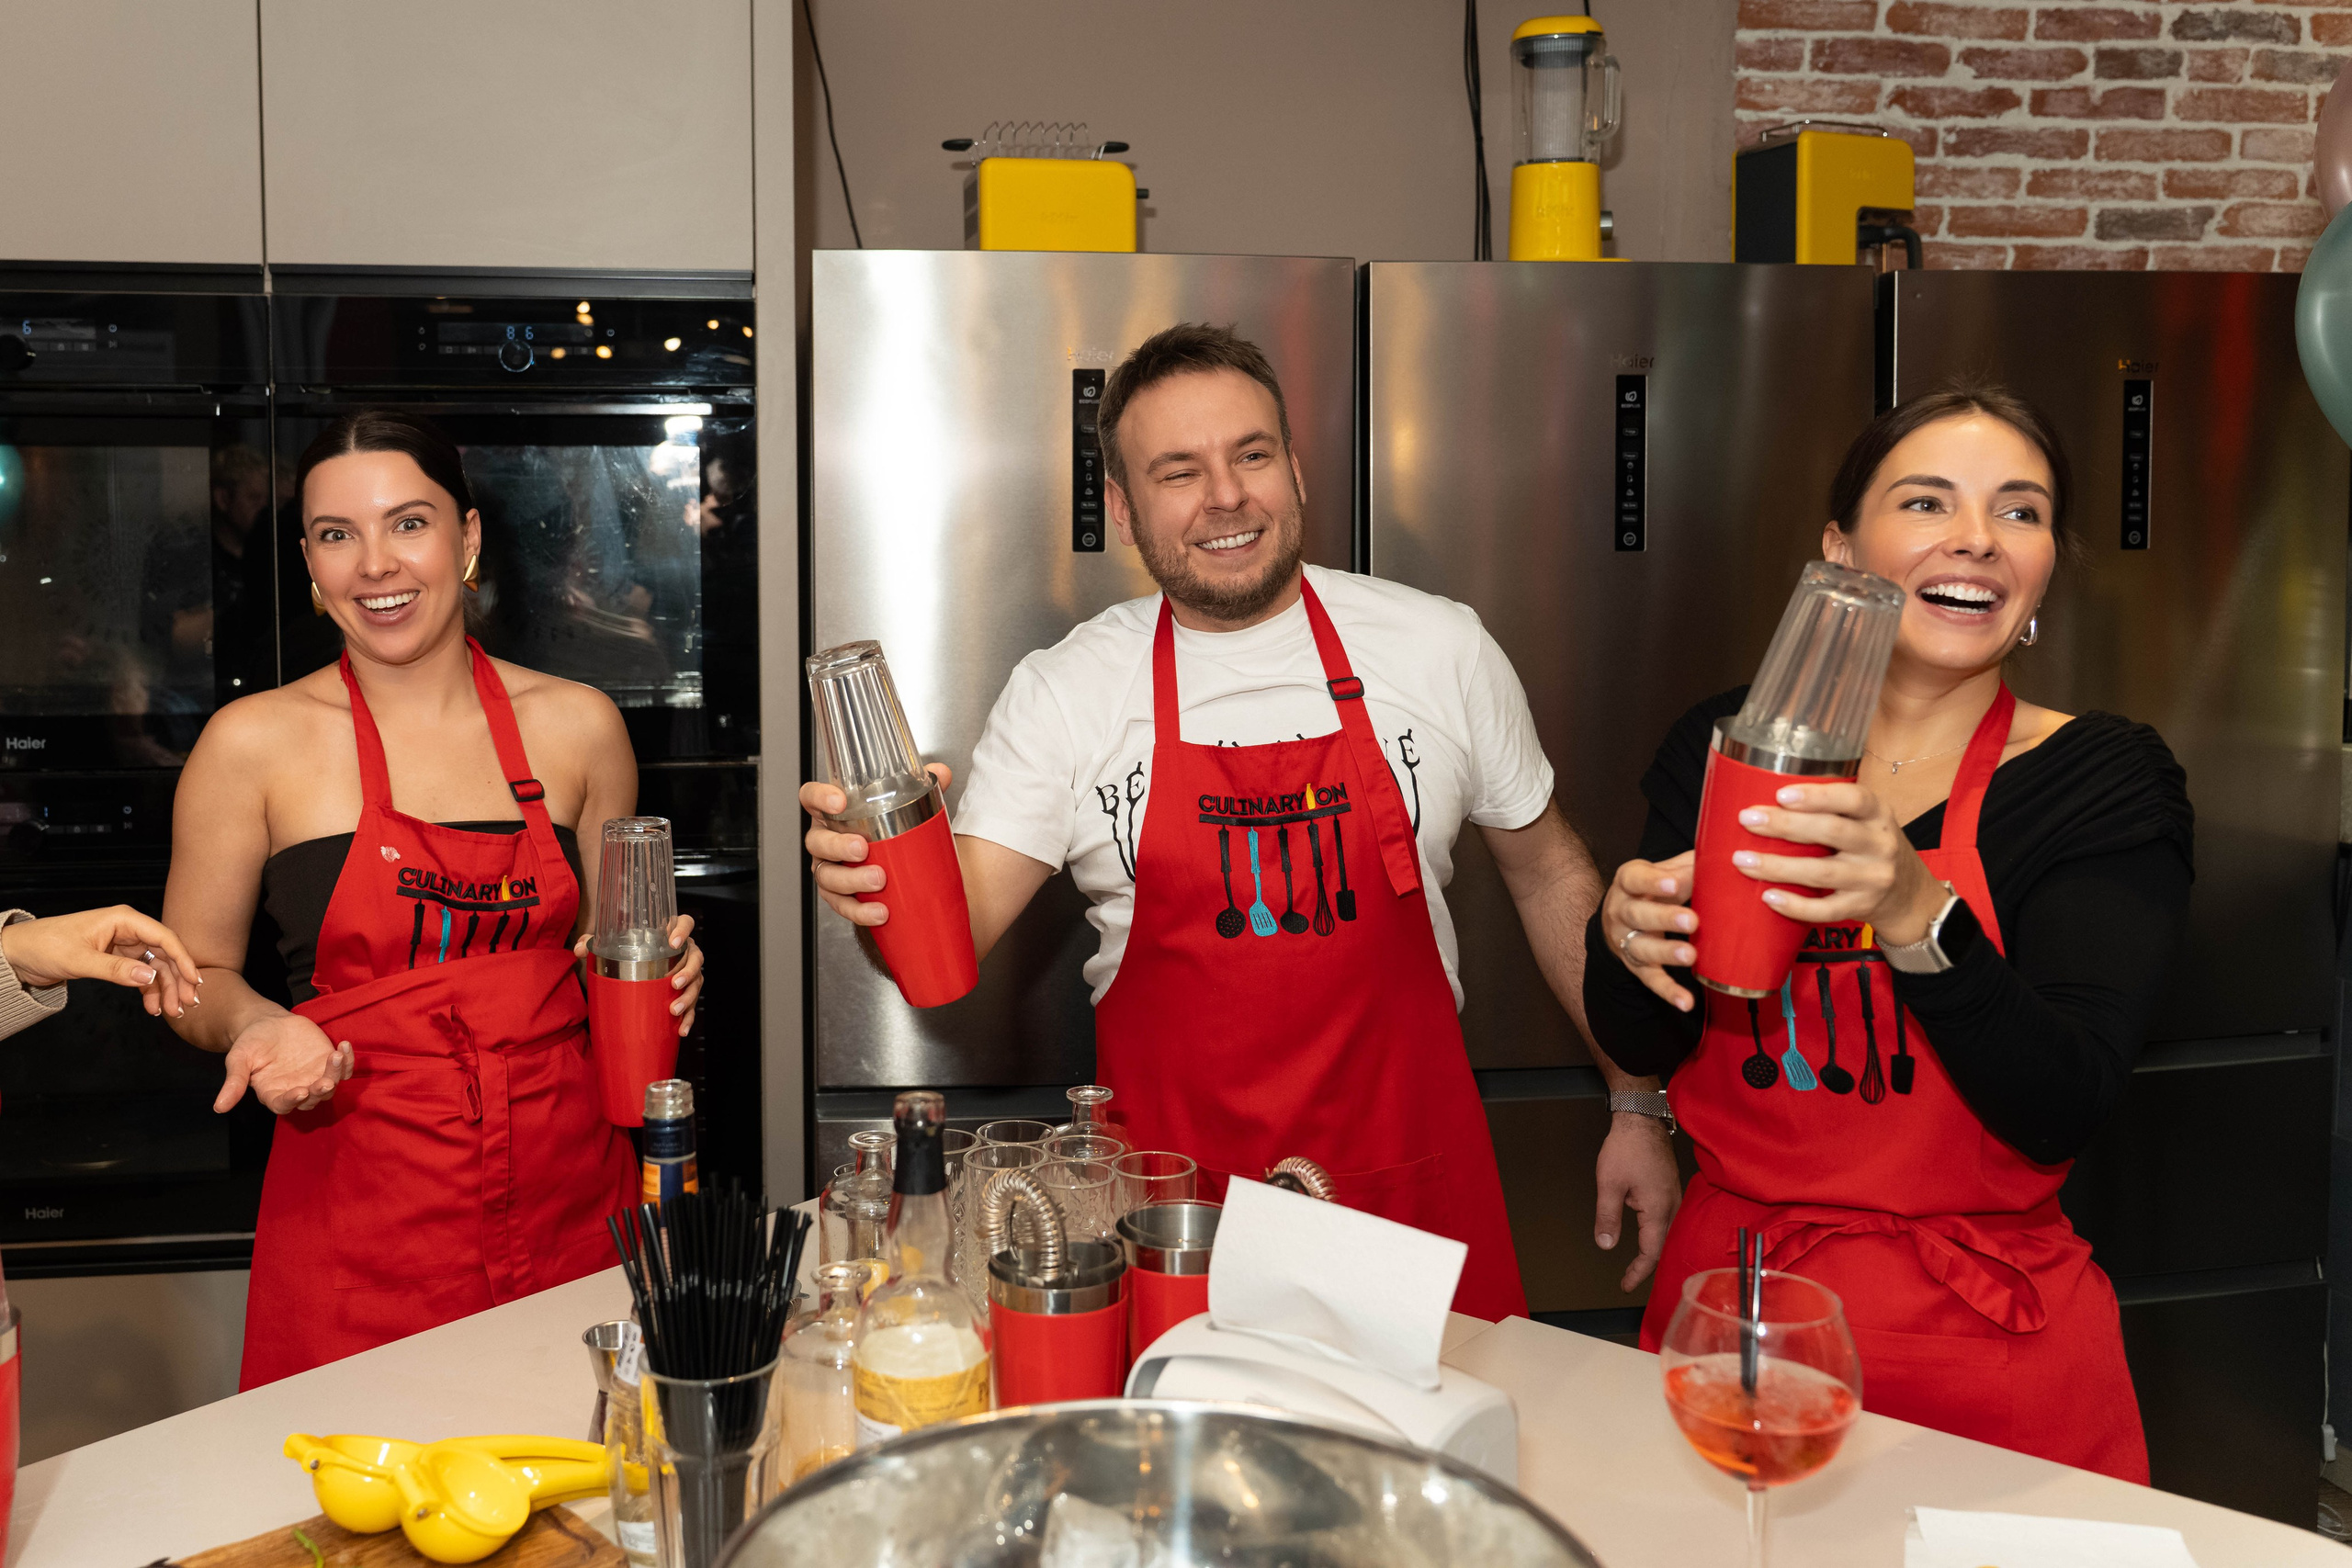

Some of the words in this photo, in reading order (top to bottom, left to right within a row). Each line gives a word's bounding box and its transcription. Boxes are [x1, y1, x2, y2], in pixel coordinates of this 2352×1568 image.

[2118, 359, 2159, 373] Haier
[6, 736, 46, 750] Haier
[25, 1206, 64, 1220] Haier
